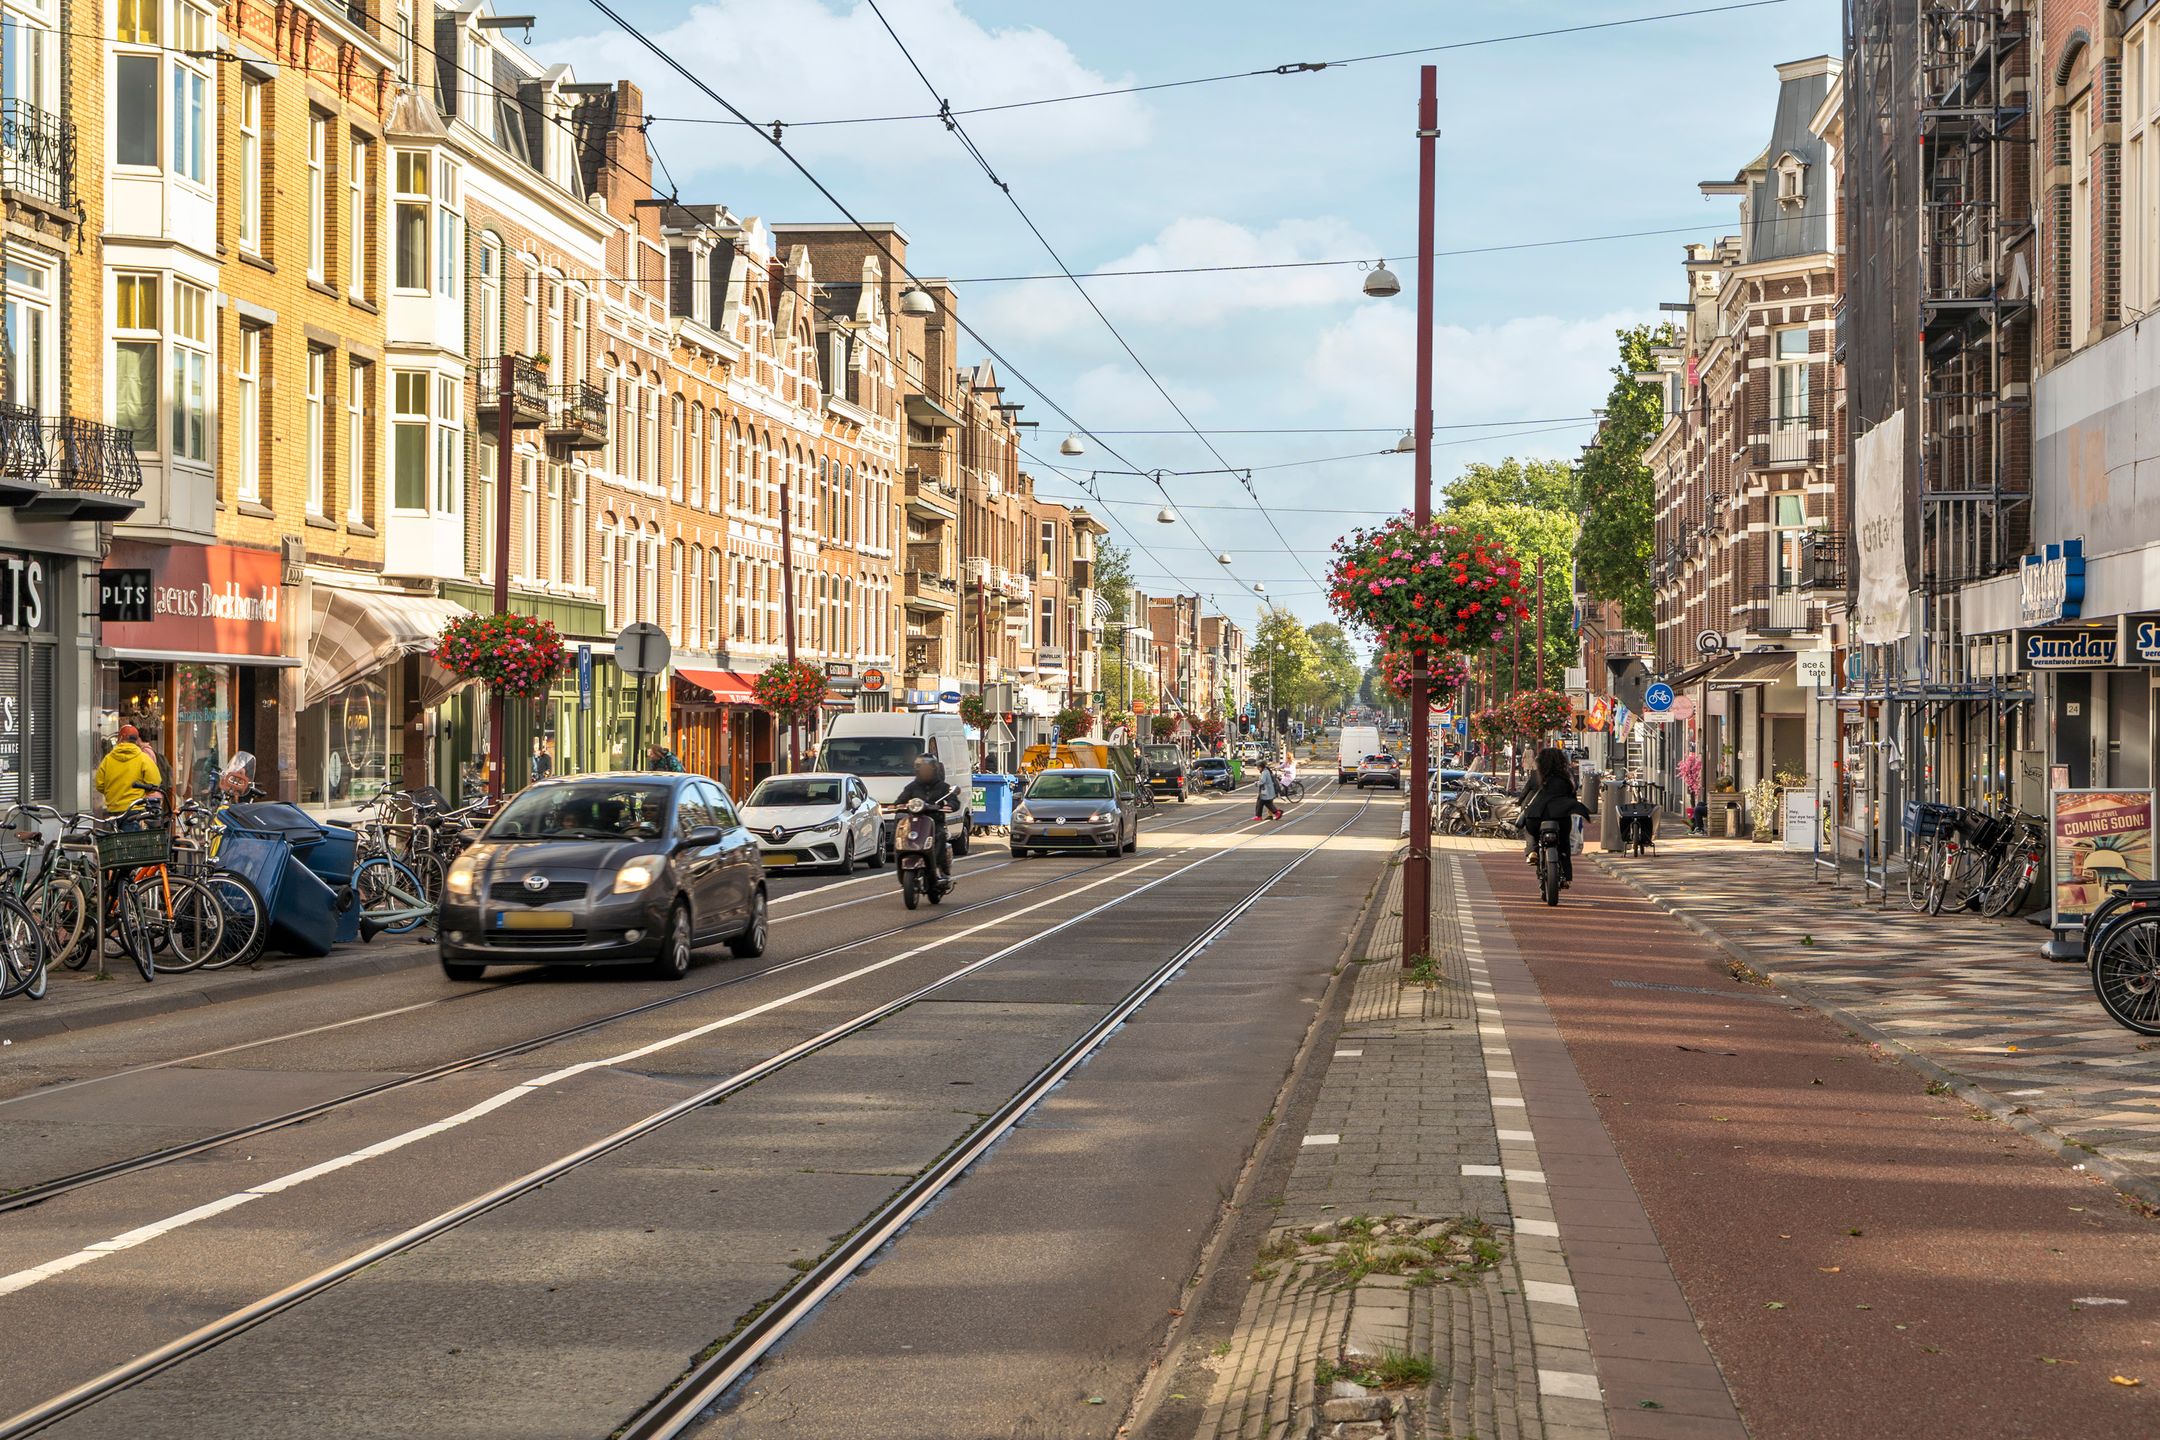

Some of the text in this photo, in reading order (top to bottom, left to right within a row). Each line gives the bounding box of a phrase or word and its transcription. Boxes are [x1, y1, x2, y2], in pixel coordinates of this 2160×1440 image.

[0, 558, 42, 628] TS
[2027, 632, 2117, 663] Sunday
[1819, 661, 1826, 669] &
[1809, 669, 1826, 677] tate
[2068, 705, 2078, 713] 24
[2101, 810, 2118, 818] JEWEL
[2064, 813, 2144, 835] COMING SOON!
